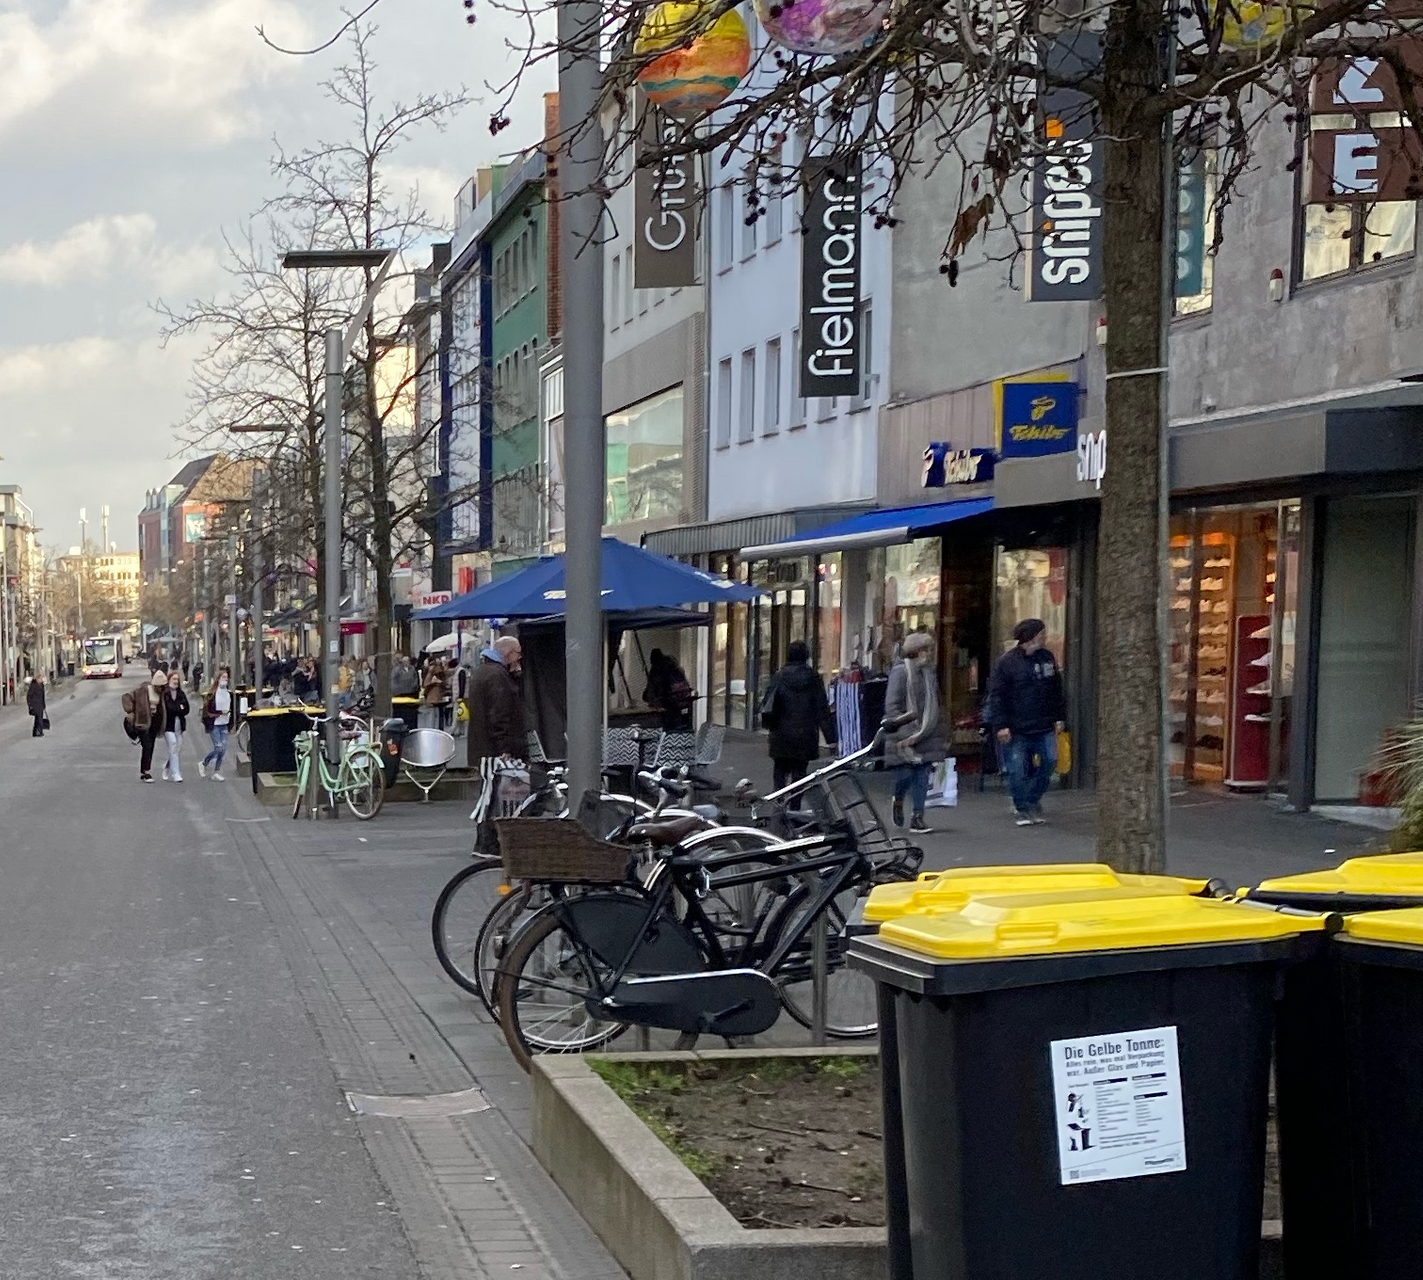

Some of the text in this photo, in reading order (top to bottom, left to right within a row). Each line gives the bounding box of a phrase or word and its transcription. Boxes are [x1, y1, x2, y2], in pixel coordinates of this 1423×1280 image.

[808, 175, 856, 377] fielmann
[1064, 1038, 1165, 1060] Die Gelbe Tonne:
